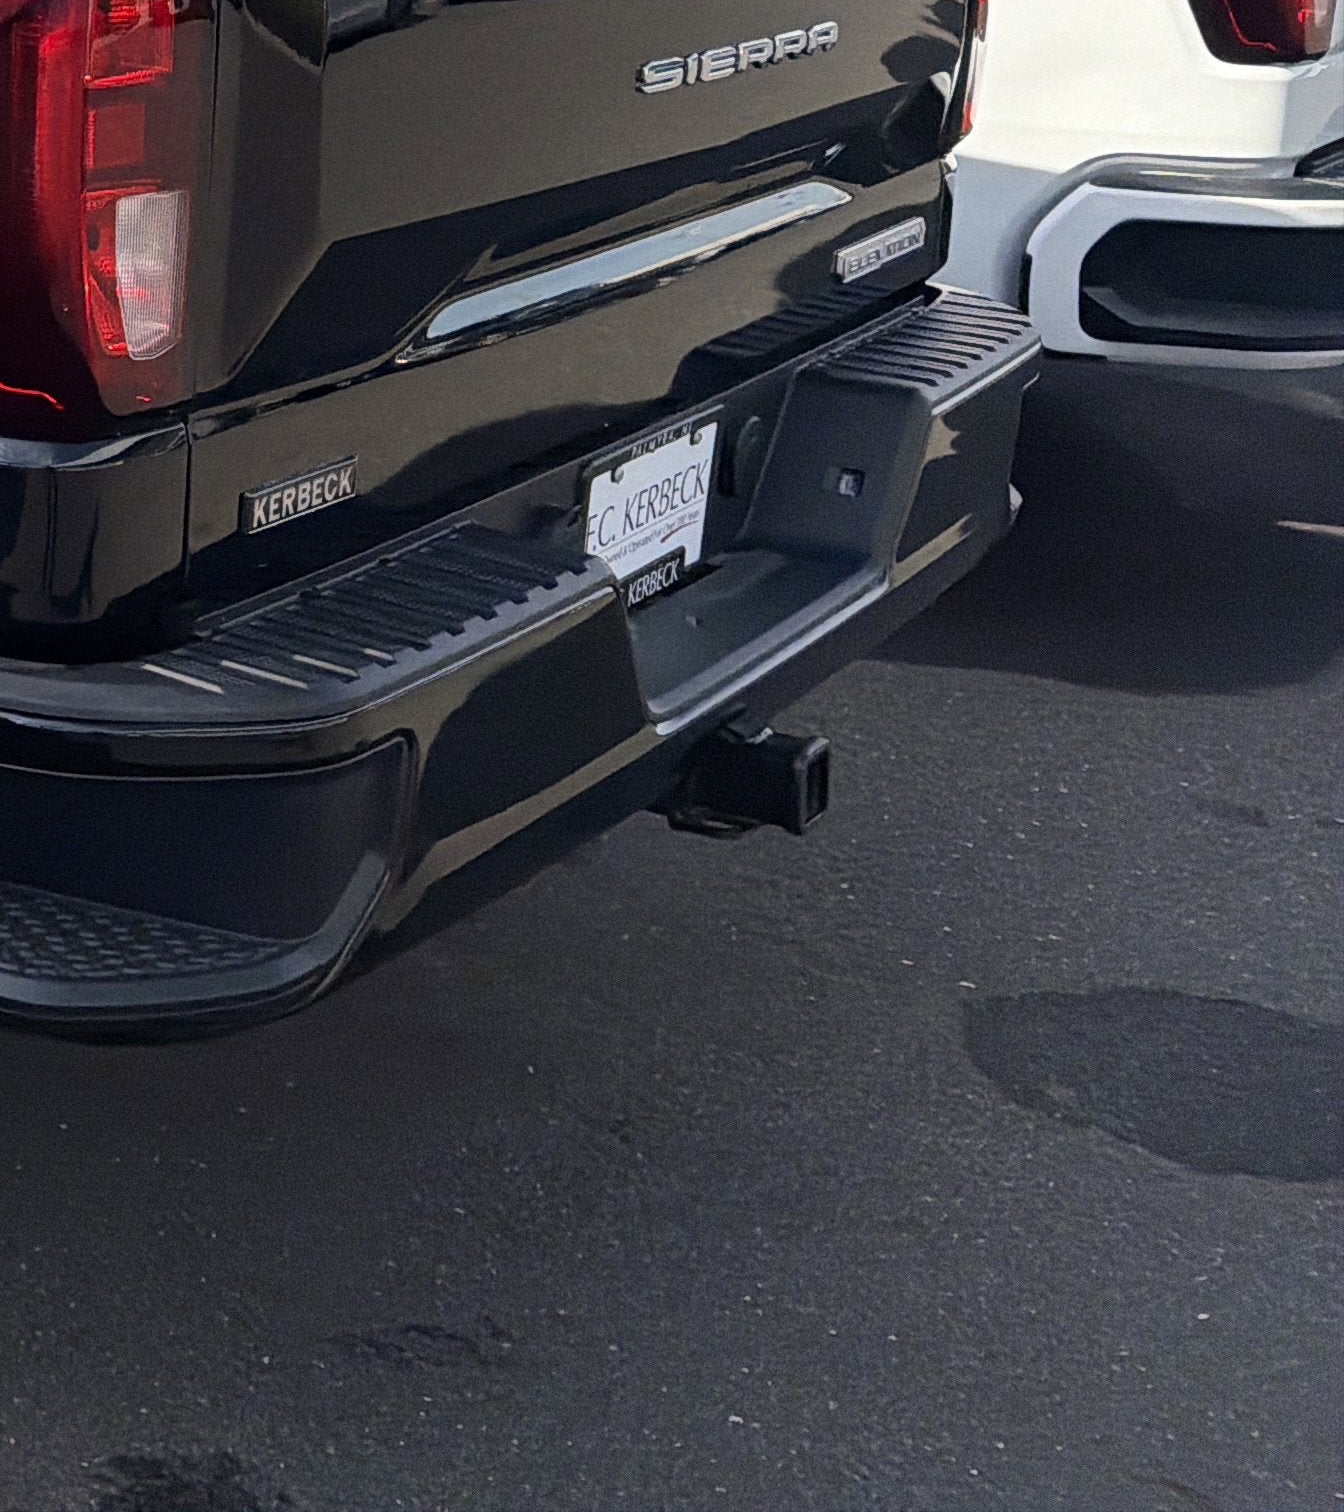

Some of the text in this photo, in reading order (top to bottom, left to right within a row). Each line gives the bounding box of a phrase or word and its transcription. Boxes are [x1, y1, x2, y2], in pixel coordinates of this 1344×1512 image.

[638, 21, 839, 94] SIERRA
[252, 466, 353, 529] KERBECK
[623, 459, 710, 536] KERBECK
[627, 557, 679, 607] KERBECK
